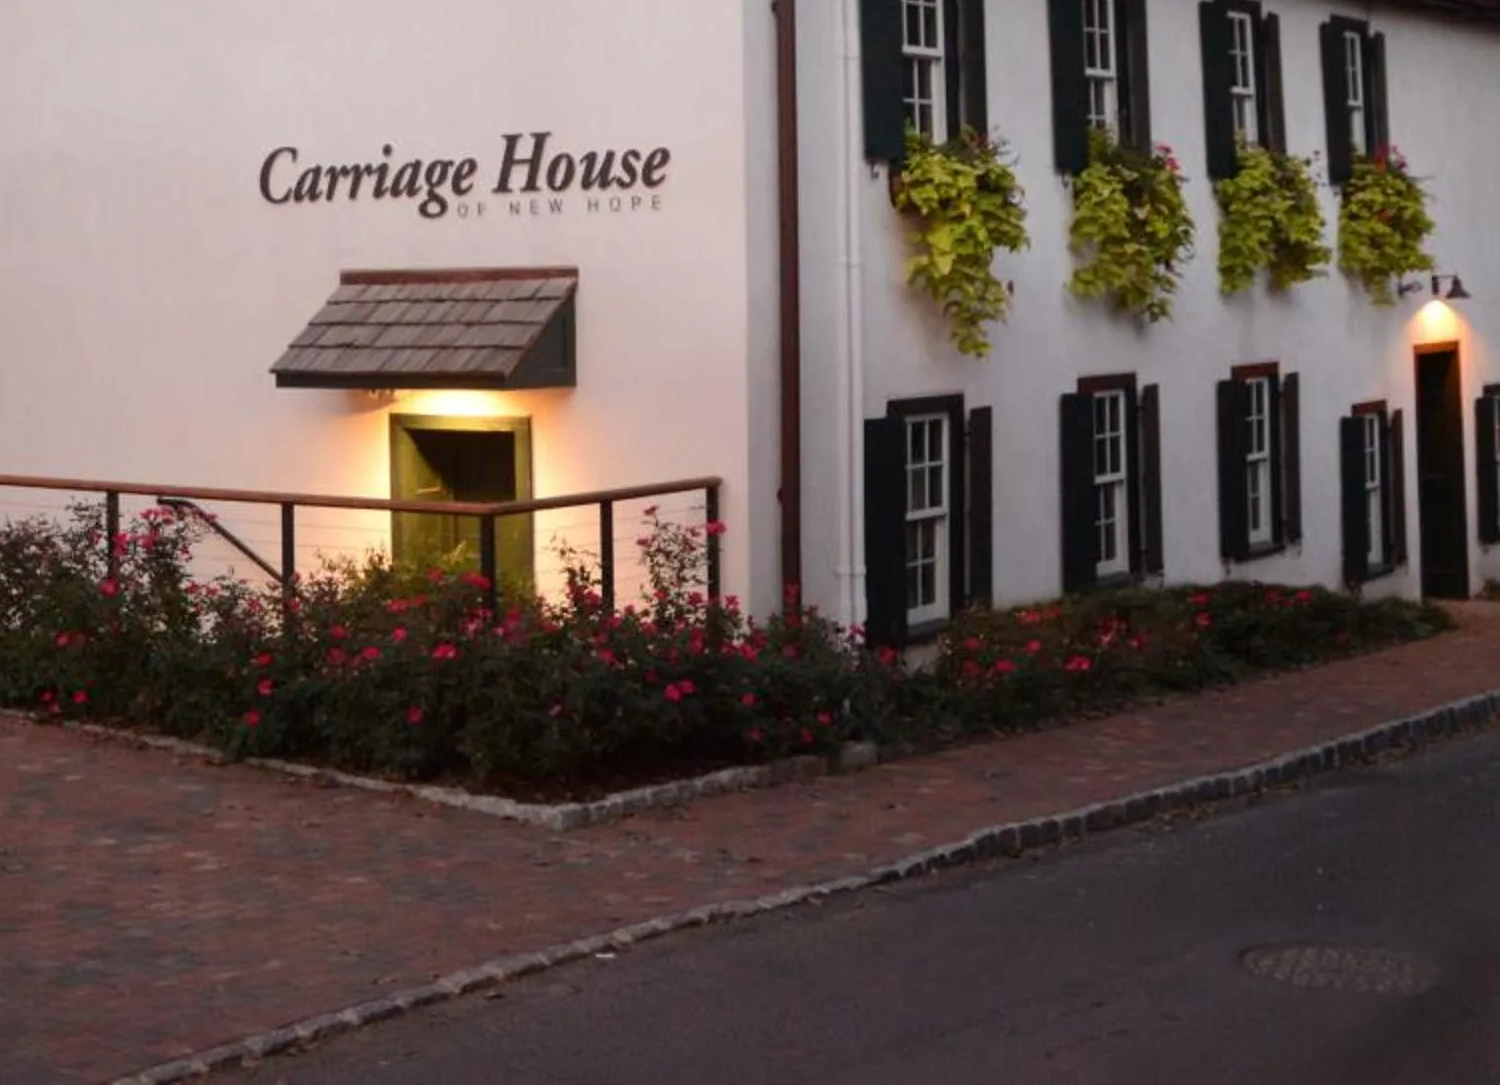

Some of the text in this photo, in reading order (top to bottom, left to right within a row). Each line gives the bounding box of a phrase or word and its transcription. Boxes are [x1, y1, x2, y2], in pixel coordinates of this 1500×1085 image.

[259, 131, 671, 219] Carriage House
[457, 195, 662, 218] OF NEW HOPE
